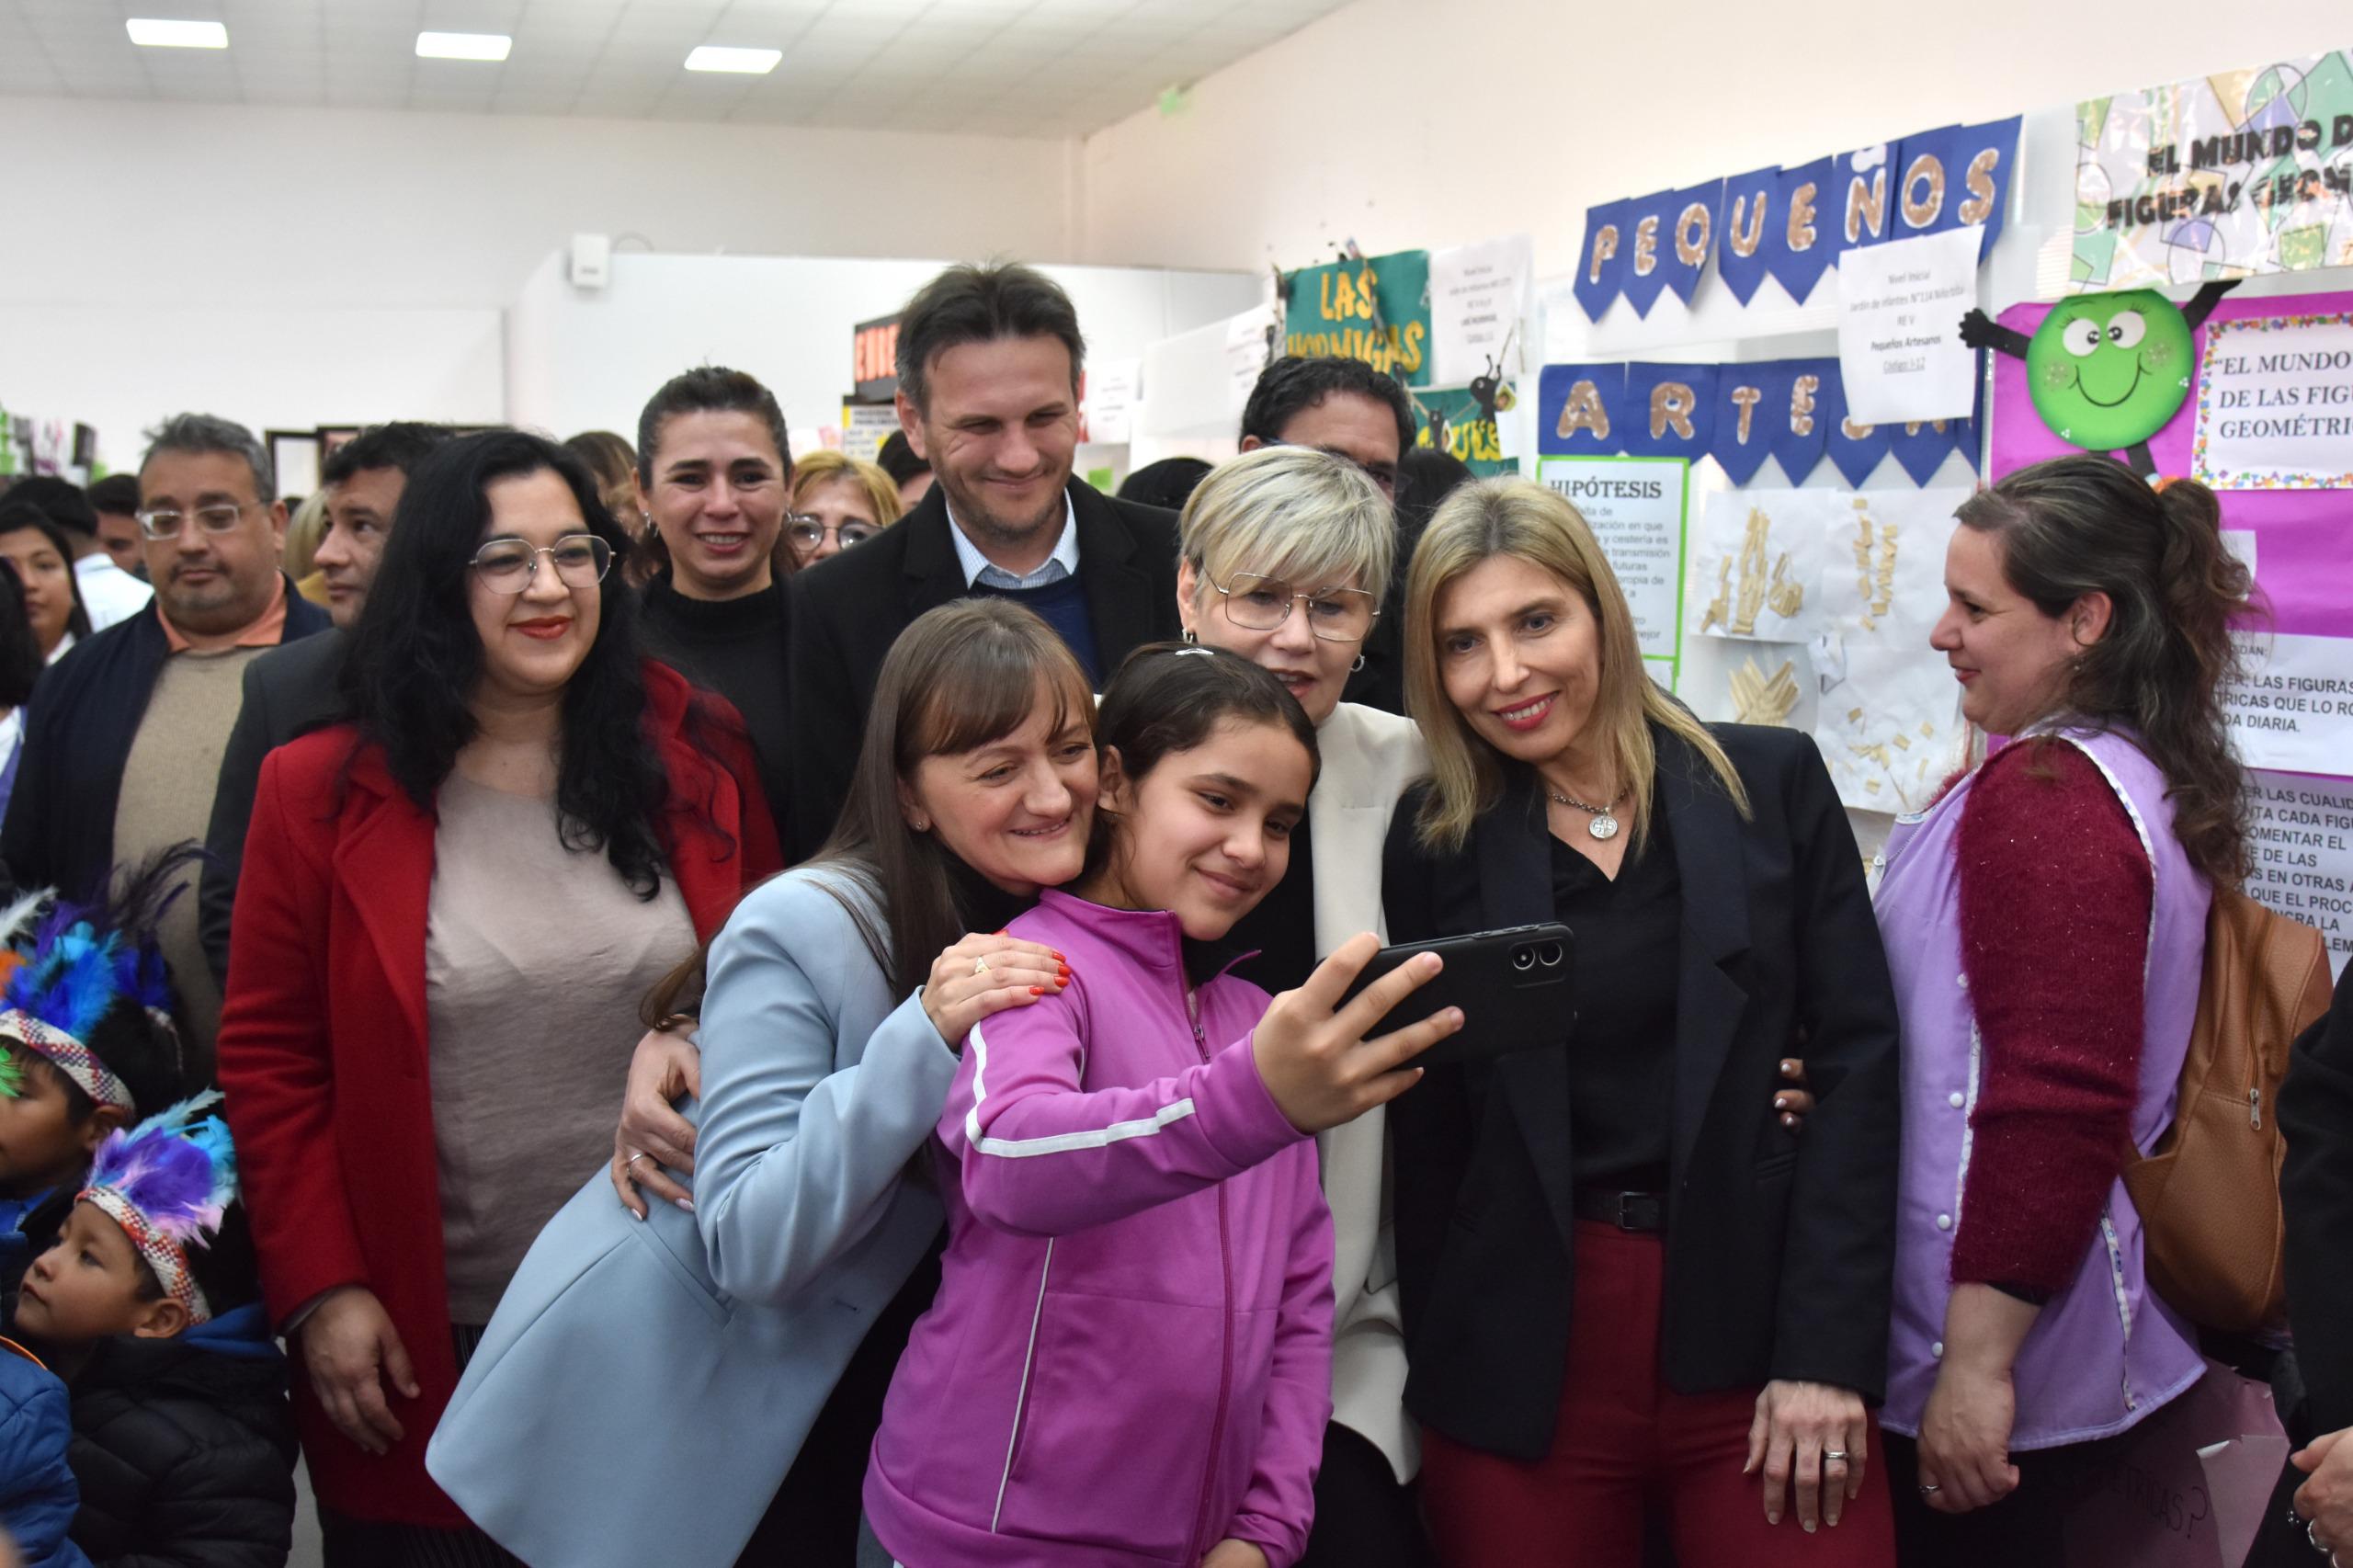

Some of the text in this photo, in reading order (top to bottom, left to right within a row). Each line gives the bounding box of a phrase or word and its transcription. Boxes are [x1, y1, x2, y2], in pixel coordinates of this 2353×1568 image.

[2147, 144, 2179, 177] EL
[2191, 120, 2322, 170] MUNDO
[1589, 142, 2000, 285] PEQUEÑOS
[2107, 182, 2241, 229] FIGURAS
[1321, 268, 1377, 322] LAS
[2257, 350, 2351, 373] MUNDO
[2219, 385, 2353, 409] DE LAS FIG
[2220, 413, 2353, 439] GEOMÉTRI
[1551, 476, 1663, 499] HIPÓTESIS
[1599, 506, 1613, 516] de
[1629, 522, 1641, 530] en
[1643, 522, 1663, 532] que
[1655, 536, 1668, 545] es
[1651, 573, 1665, 585] de
[2254, 675, 2283, 689] LAS
[2274, 697, 2306, 712] QUE
[2312, 700, 2332, 714] LO
[2247, 715, 2301, 733] DIARIA.
[2267, 789, 2296, 803] LAS
[2278, 809, 2321, 826] CADA
[2325, 814, 2353, 831] FIG
[2245, 825, 2347, 850] OMENTAR EL
[2264, 848, 2283, 863] DE
[2288, 852, 2317, 868] LAS
[2268, 869, 2287, 884] EN
[2291, 872, 2345, 892] OTRAS
[2251, 887, 2281, 903] QUE
[2286, 892, 2304, 907] EL
[2321, 917, 2340, 932] LA
